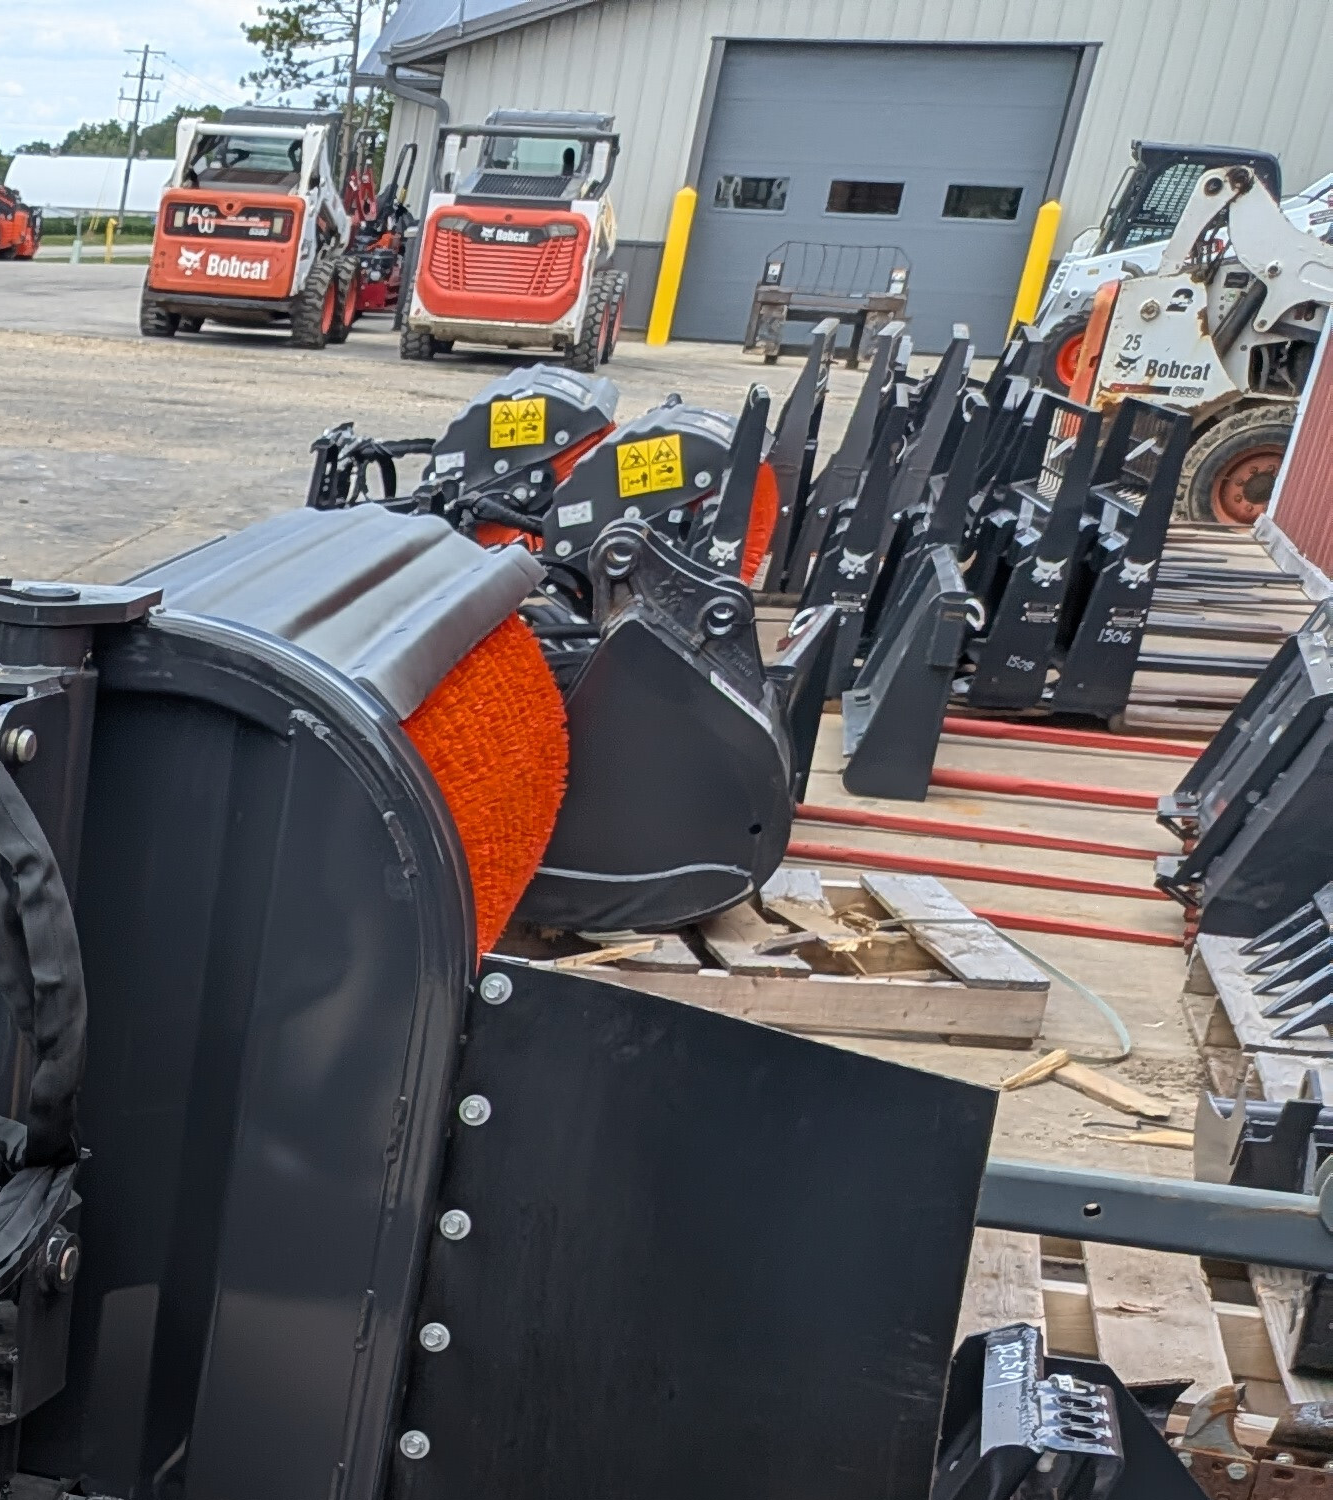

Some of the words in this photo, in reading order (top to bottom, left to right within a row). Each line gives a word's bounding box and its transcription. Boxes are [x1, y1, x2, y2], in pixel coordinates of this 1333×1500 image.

[495, 229, 530, 243] Bobcat
[205, 253, 271, 280] Bobcat
[1122, 334, 1142, 351] 25
[1144, 359, 1211, 380] Bobcat
[1097, 628, 1132, 644] 1506
